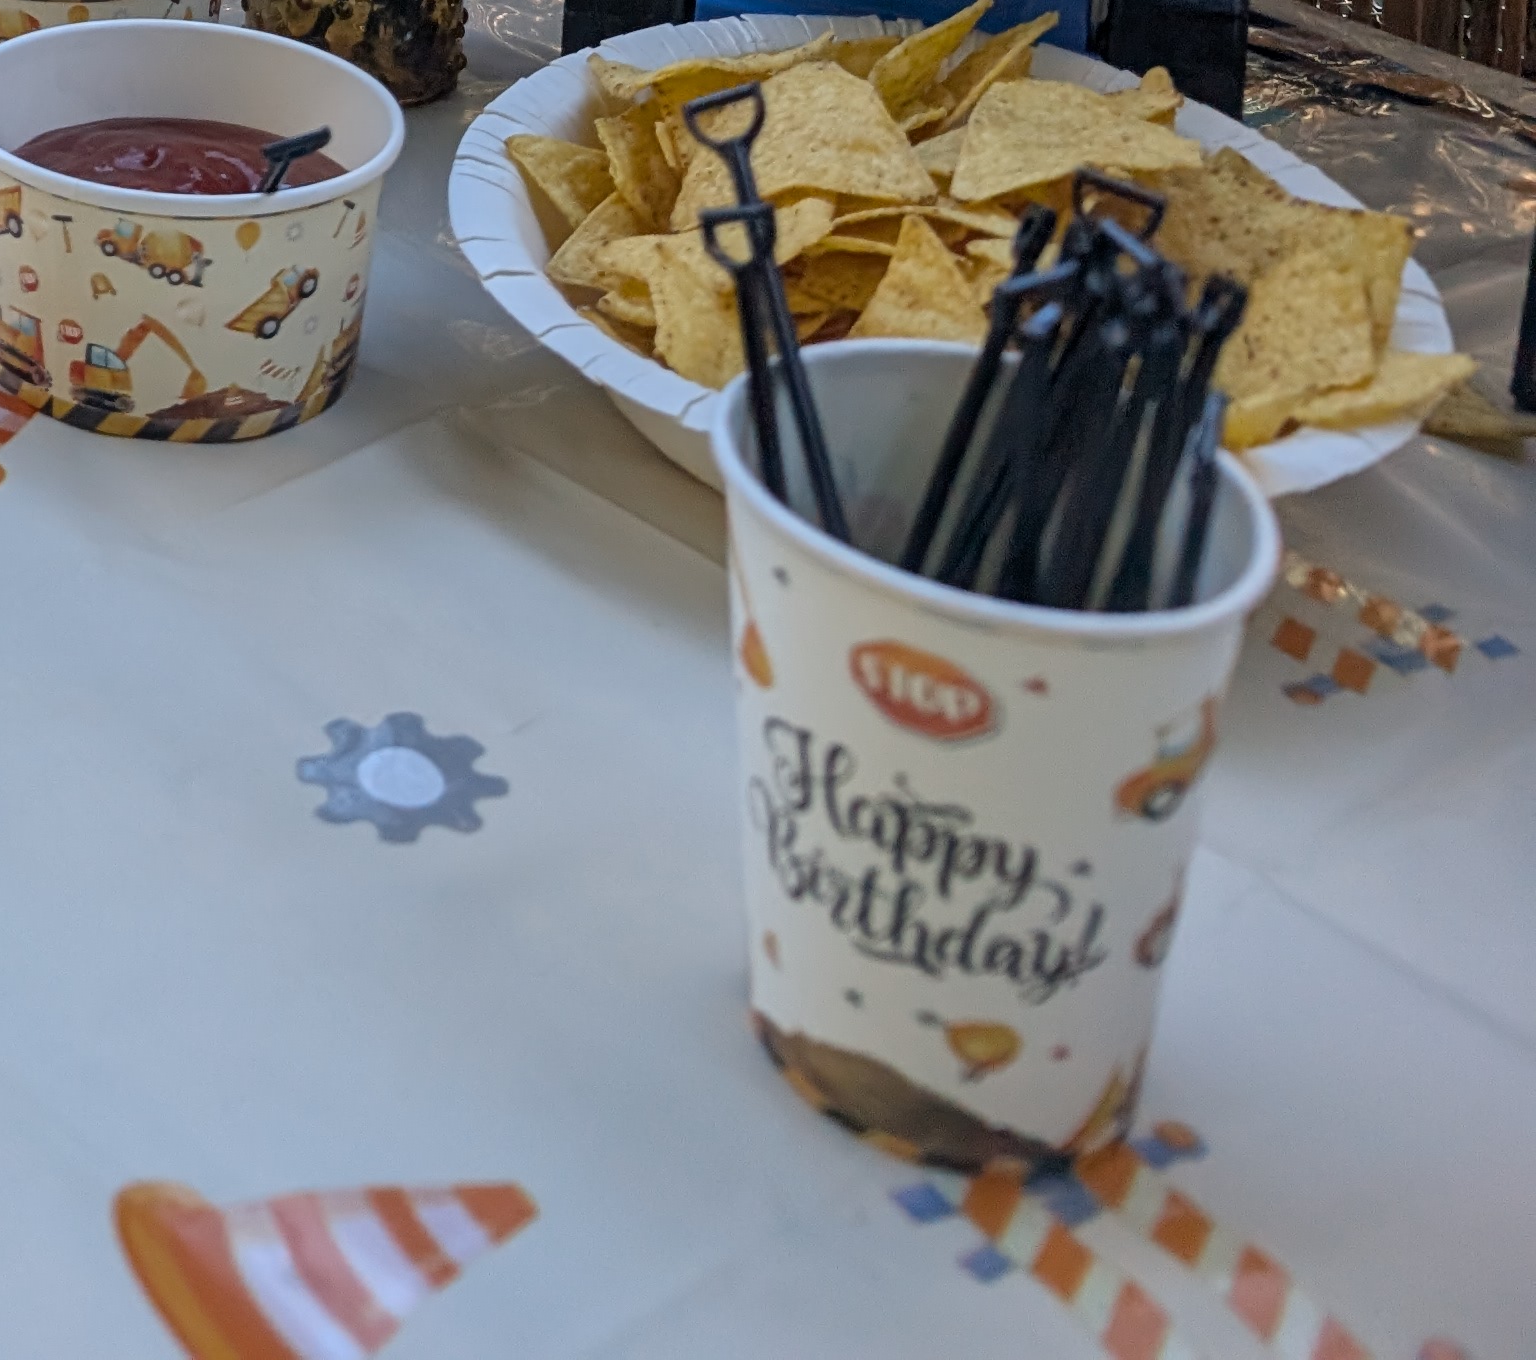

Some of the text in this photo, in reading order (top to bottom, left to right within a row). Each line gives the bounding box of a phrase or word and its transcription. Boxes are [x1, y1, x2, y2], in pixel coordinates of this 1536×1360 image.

[859, 651, 983, 724] STOP
[748, 774, 1109, 1007] Birthday!
[763, 715, 1071, 923] Happy
